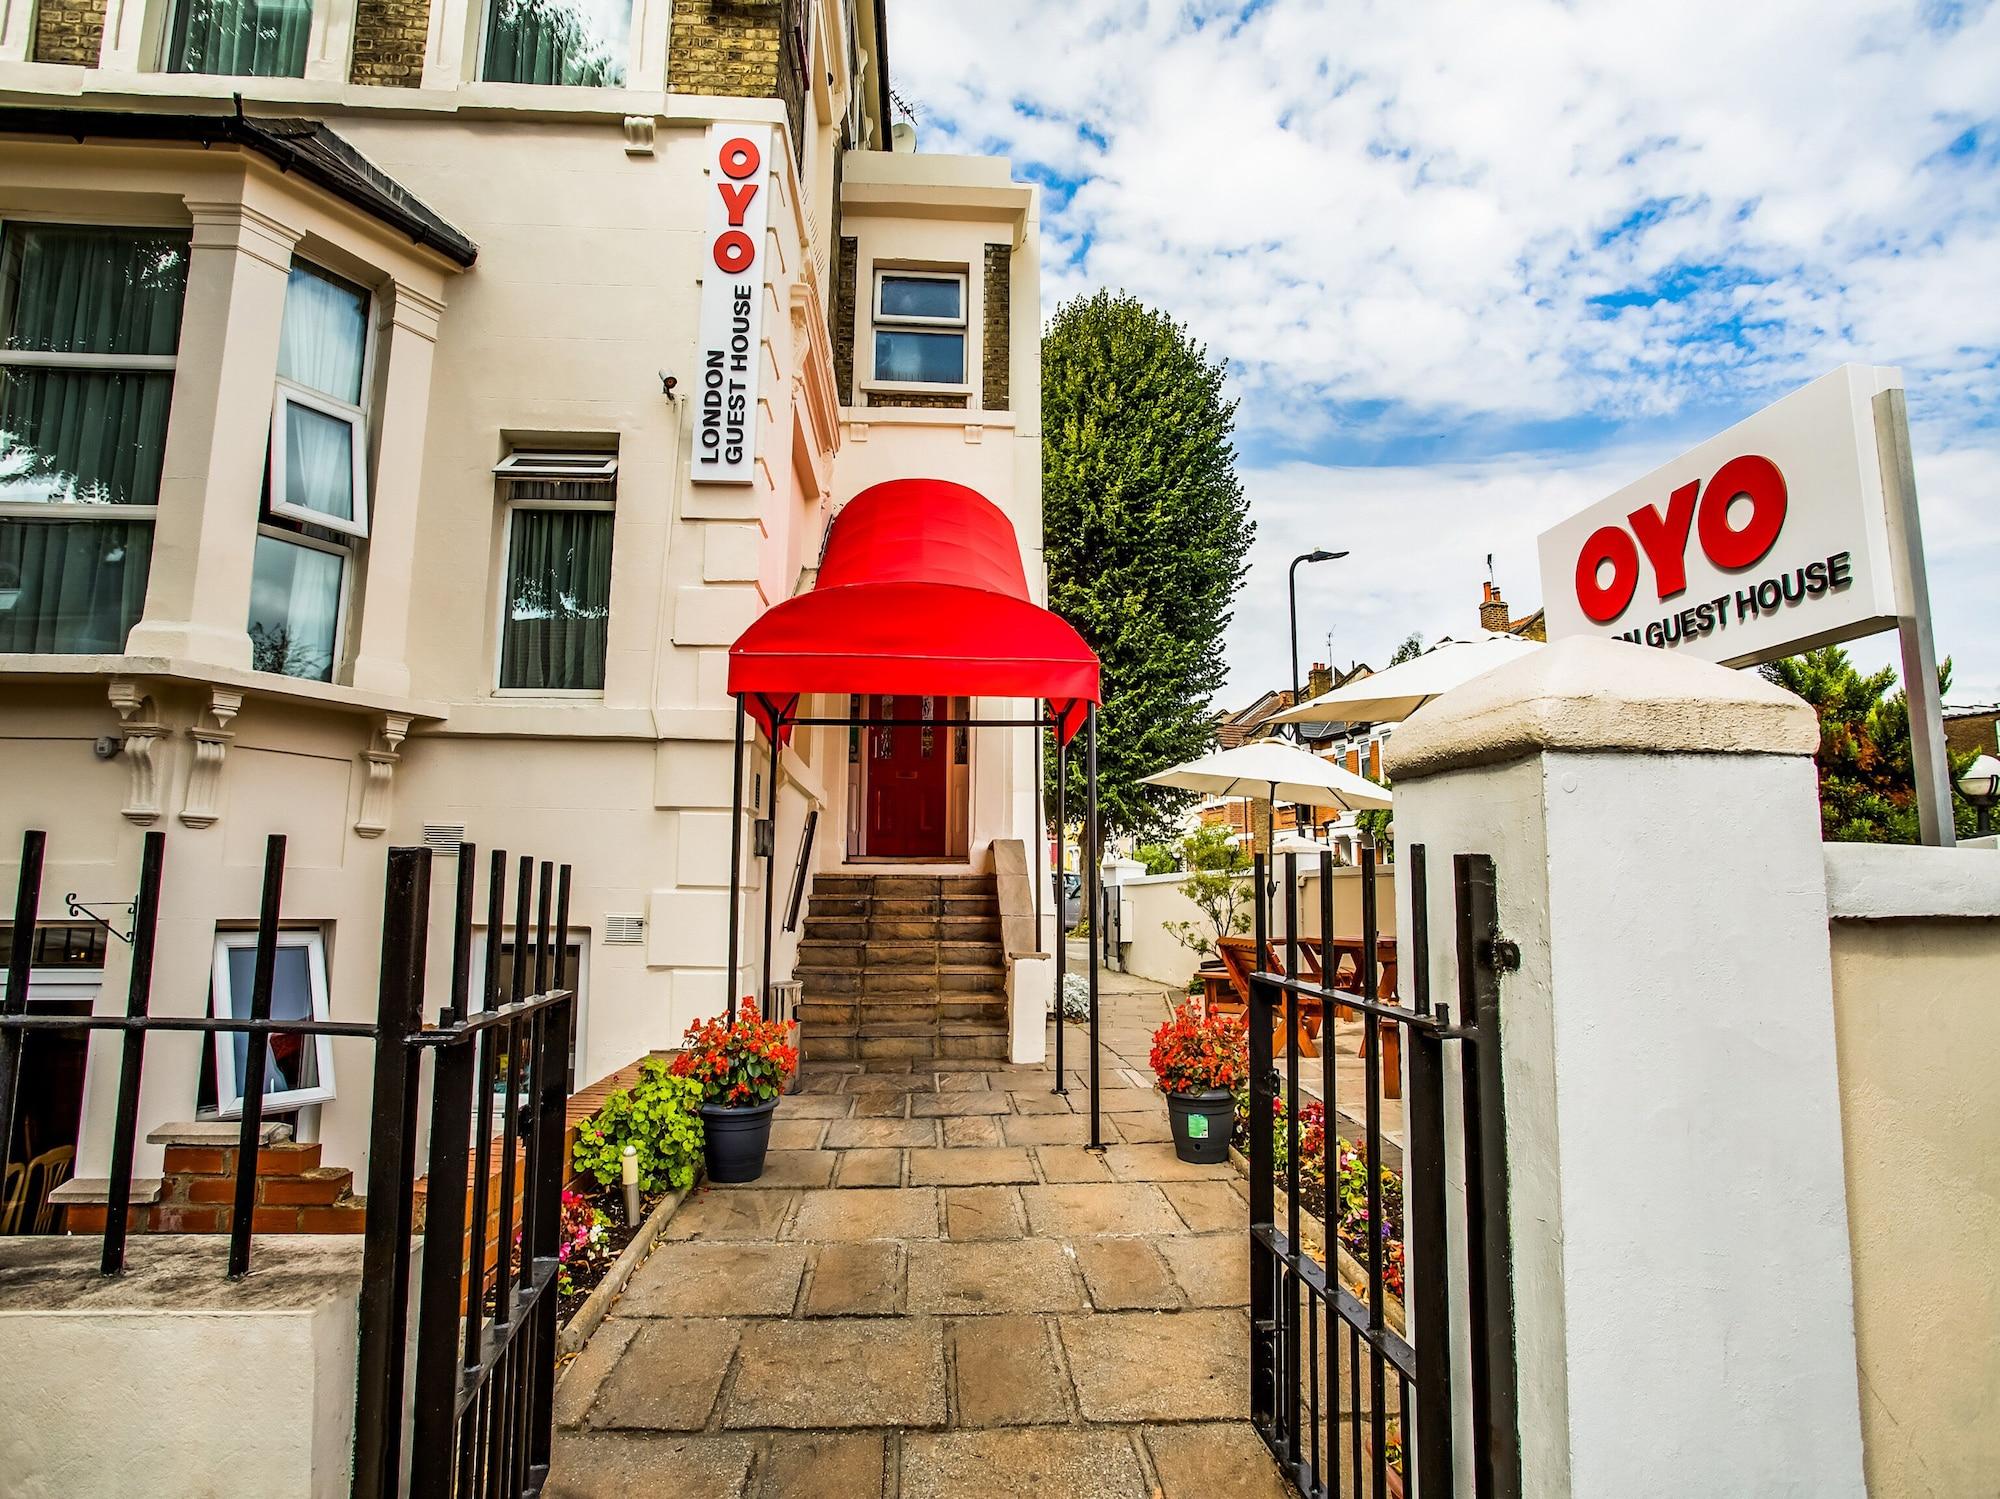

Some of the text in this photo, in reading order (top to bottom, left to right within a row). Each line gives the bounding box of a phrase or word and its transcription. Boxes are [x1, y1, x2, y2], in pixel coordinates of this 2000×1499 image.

[713, 137, 761, 273] OYO
[700, 350, 725, 464] LONDON
[725, 284, 752, 465] GUEST HOUSE
[1575, 454, 1788, 622] OYO
[1645, 551, 1853, 649] GUEST HOUSE
